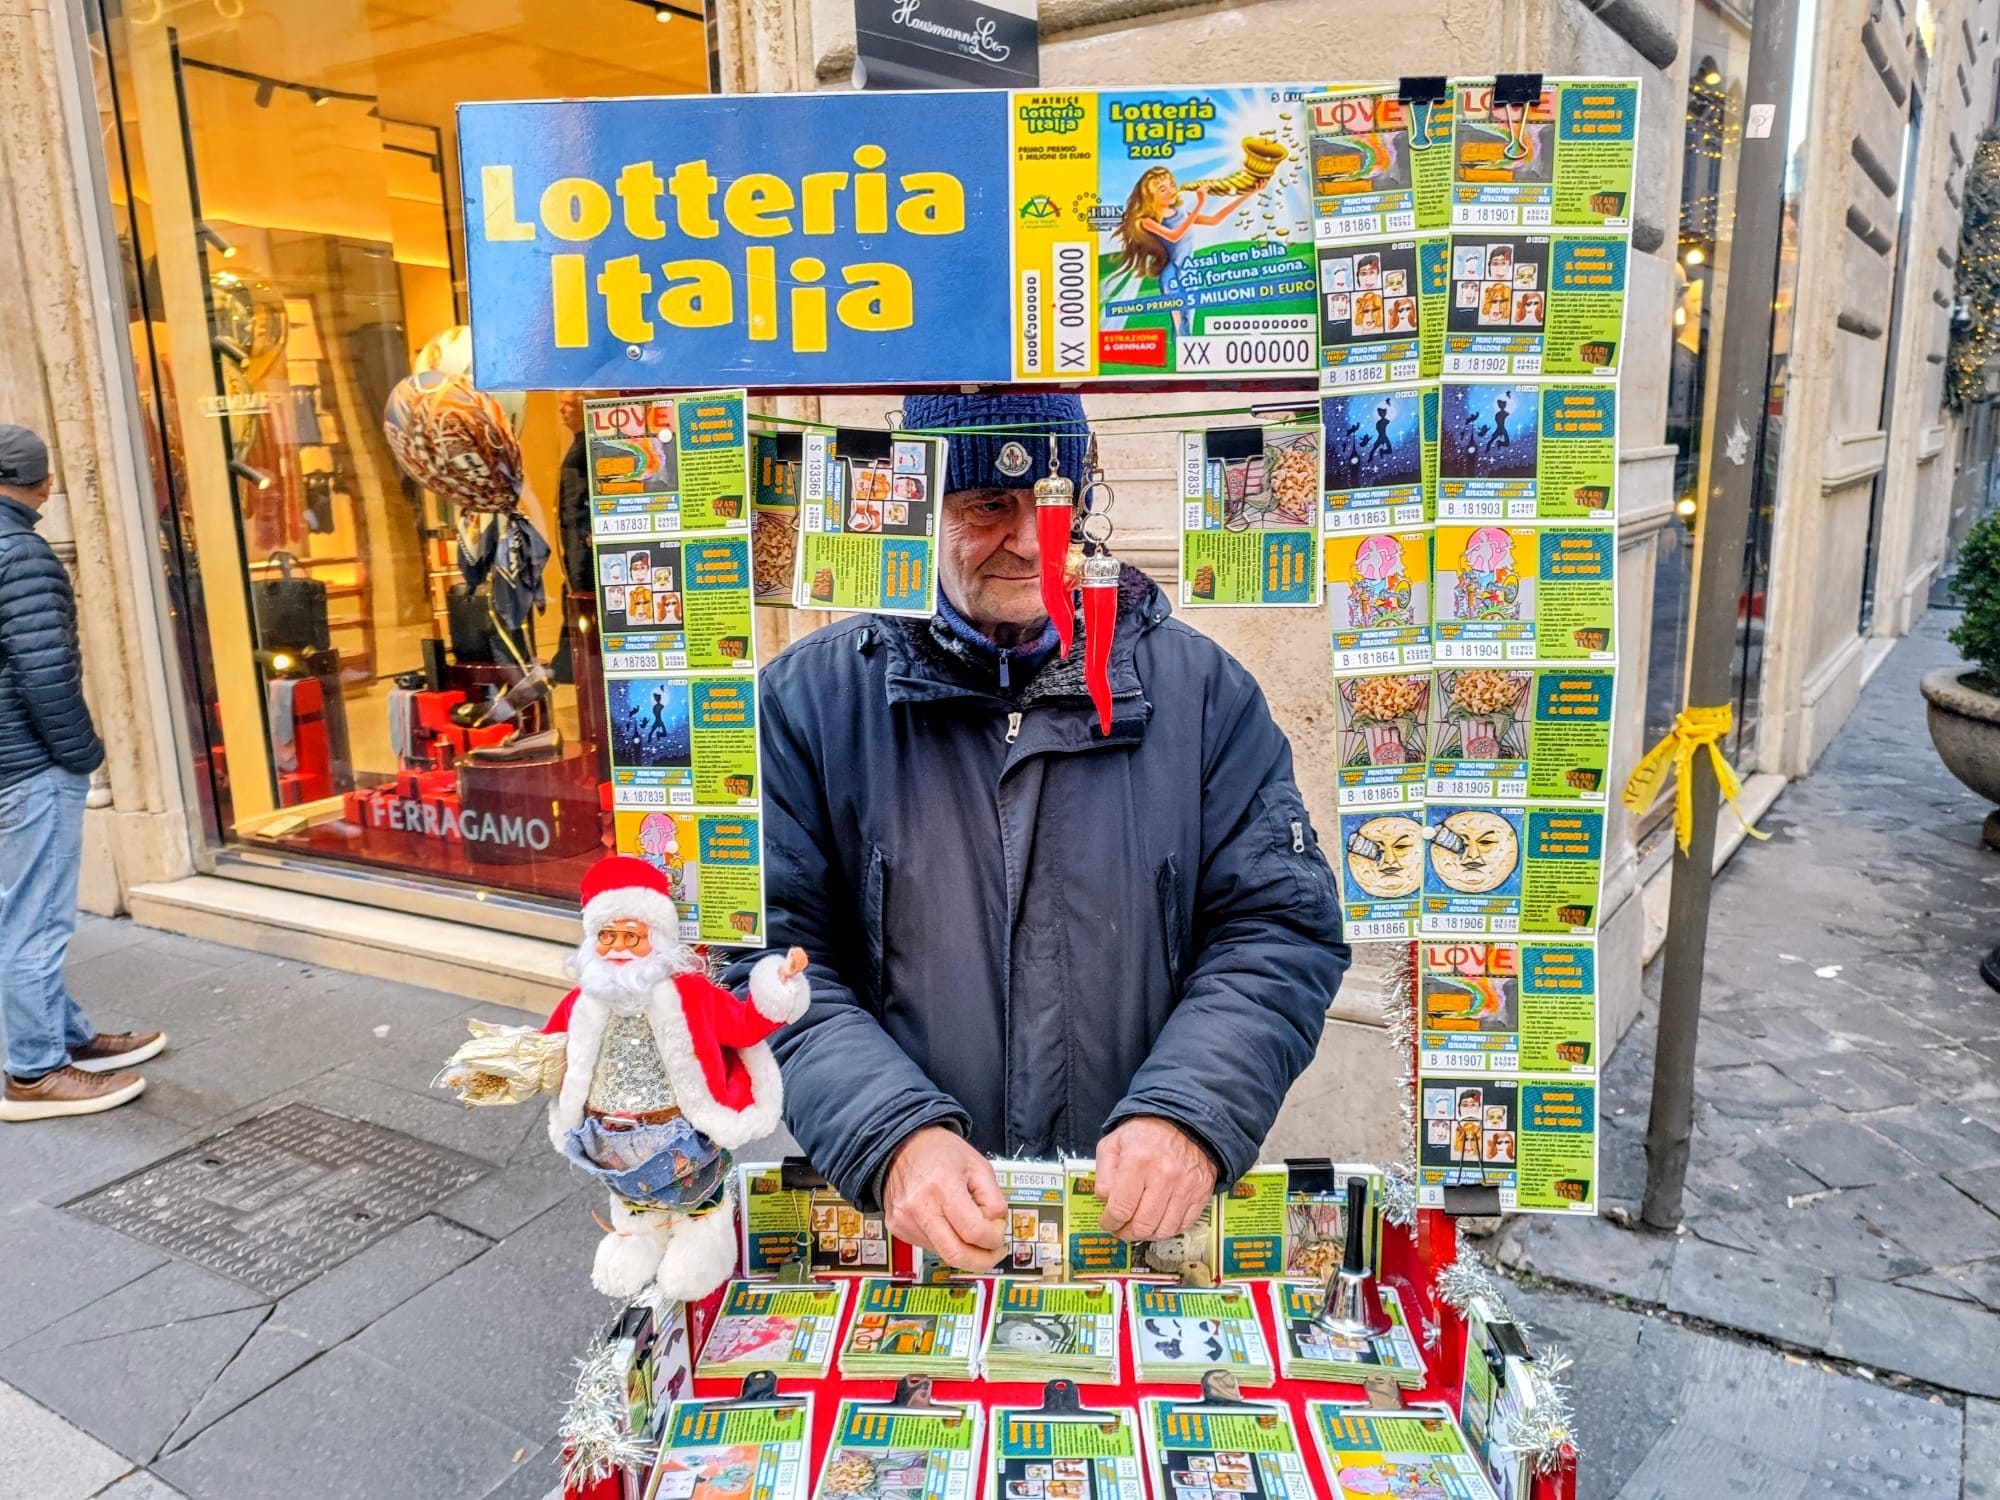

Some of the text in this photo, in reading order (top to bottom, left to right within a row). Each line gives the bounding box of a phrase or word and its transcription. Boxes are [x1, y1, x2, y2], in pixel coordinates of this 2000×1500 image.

[1020, 105, 1085, 120] Lotteria
[1110, 98, 1215, 121] Lotteria
[1314, 96, 1402, 127] LOVE
[1027, 119, 1078, 134] Italia
[1124, 120, 1204, 144] Italia
[1130, 143, 1174, 158] 2016
[481, 144, 965, 241] Lotteria
[1463, 209, 1514, 220] B 181901
[1325, 218, 1377, 234] B 181861
[1182, 243, 1286, 271] Assai ben balla
[1169, 261, 1308, 289] a chi fortuna suona.
[550, 245, 914, 353] Italia
[1111, 279, 1316, 315] PRIMO PREMIO 5 MILIONI DI EURO
[1059, 248, 1085, 367] XX 000000
[1104, 335, 1159, 343] ESTRAZIONE
[1112, 342, 1157, 351] GENNAIO
[1182, 338, 1310, 366] XX 000000
[1454, 358, 1505, 370] B 181902
[1330, 367, 1382, 383] B 181862
[594, 406, 670, 431] LOVE
[809, 459, 821, 496] 133366
[1188, 458, 1199, 495] 187835
[1448, 503, 1500, 515] B 181903
[603, 518, 648, 530] A 187837
[1334, 511, 1386, 526] B 181863
[1343, 652, 1395, 665] B 181864
[1446, 645, 1498, 657] B 181904
[613, 656, 657, 667] A 187838
[1348, 788, 1399, 801] B 181865
[1437, 781, 1490, 793] B 181905
[623, 791, 664, 802] A 187839
[371, 798, 550, 850] FERRAGAMO
[1354, 923, 1405, 935] B 181866
[1446, 917, 1483, 928] 181906
[1429, 946, 1513, 969] LOVE
[1431, 1054, 1482, 1066] B 181907
[1429, 1189, 1436, 1201] B
